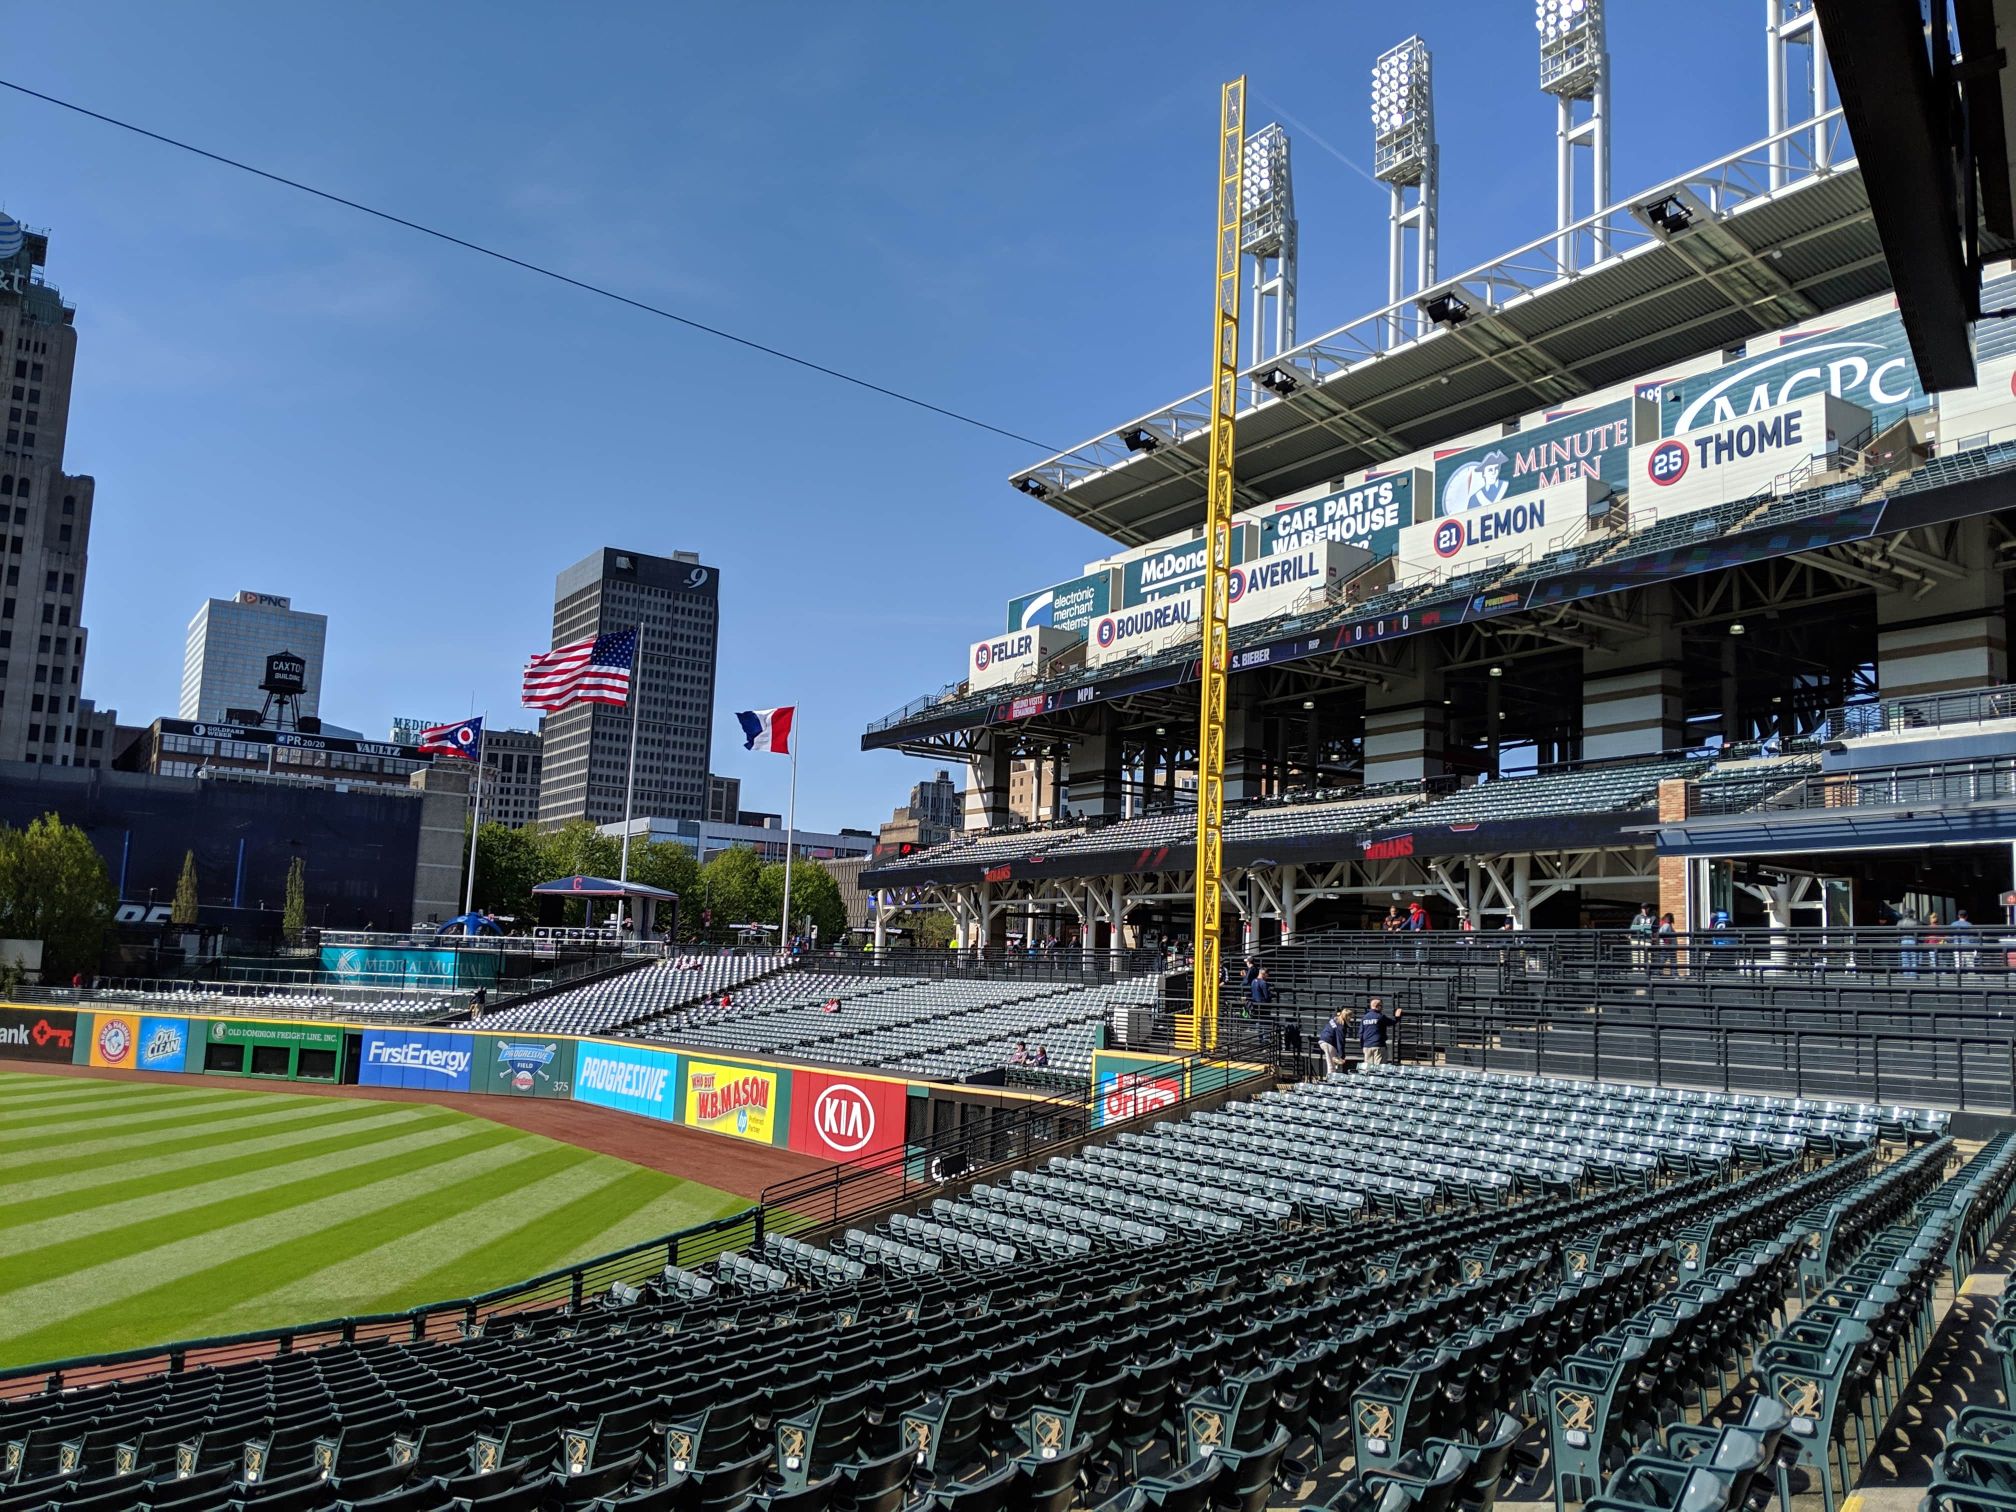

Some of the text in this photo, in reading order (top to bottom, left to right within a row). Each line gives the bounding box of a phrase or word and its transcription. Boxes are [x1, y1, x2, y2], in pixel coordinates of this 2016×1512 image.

[1513, 418, 1628, 478] MINUTE
[1654, 410, 1803, 475] 25 THOME
[1539, 455, 1602, 490] MEN
[1277, 482, 1393, 537] CAR PARTS
[1272, 502, 1399, 555] WAREHOUSE
[1439, 499, 1545, 549] 21 LEMON
[1230, 578, 1239, 594] 3
[1247, 552, 1319, 593] AVERILL
[259, 596, 287, 609] PNC
[1054, 586, 1095, 609] electronic
[1053, 599, 1093, 620] merchant
[1102, 599, 1191, 640] 5 BOUDREAU
[1356, 625, 1362, 641] 0
[1378, 620, 1384, 636] 0
[1402, 614, 1409, 630] 0
[977, 634, 1032, 665] 19 FELLER
[1242, 648, 1270, 668] BIEBER
[1047, 696, 1053, 709] 5
[1076, 686, 1094, 703] MPH
[207, 731, 233, 739] WEBER
[286, 735, 326, 749] PR 20/20
[355, 742, 403, 757] VAULTZ
[364, 958, 423, 973] MEDICAL
[155, 1030, 175, 1045] OXI
[228, 1029, 241, 1037] OLD
[242, 1030, 275, 1039] DOMINION
[277, 1032, 305, 1040] FREIGHT
[147, 1039, 180, 1059] CLEAN
[503, 1049, 549, 1061] PROGRESSIVE
[552, 1081, 569, 1092] 375
[579, 1056, 670, 1103] PROGRESSIVE
[704, 1076, 716, 1089] BUT
[823, 1097, 865, 1139] KIA
